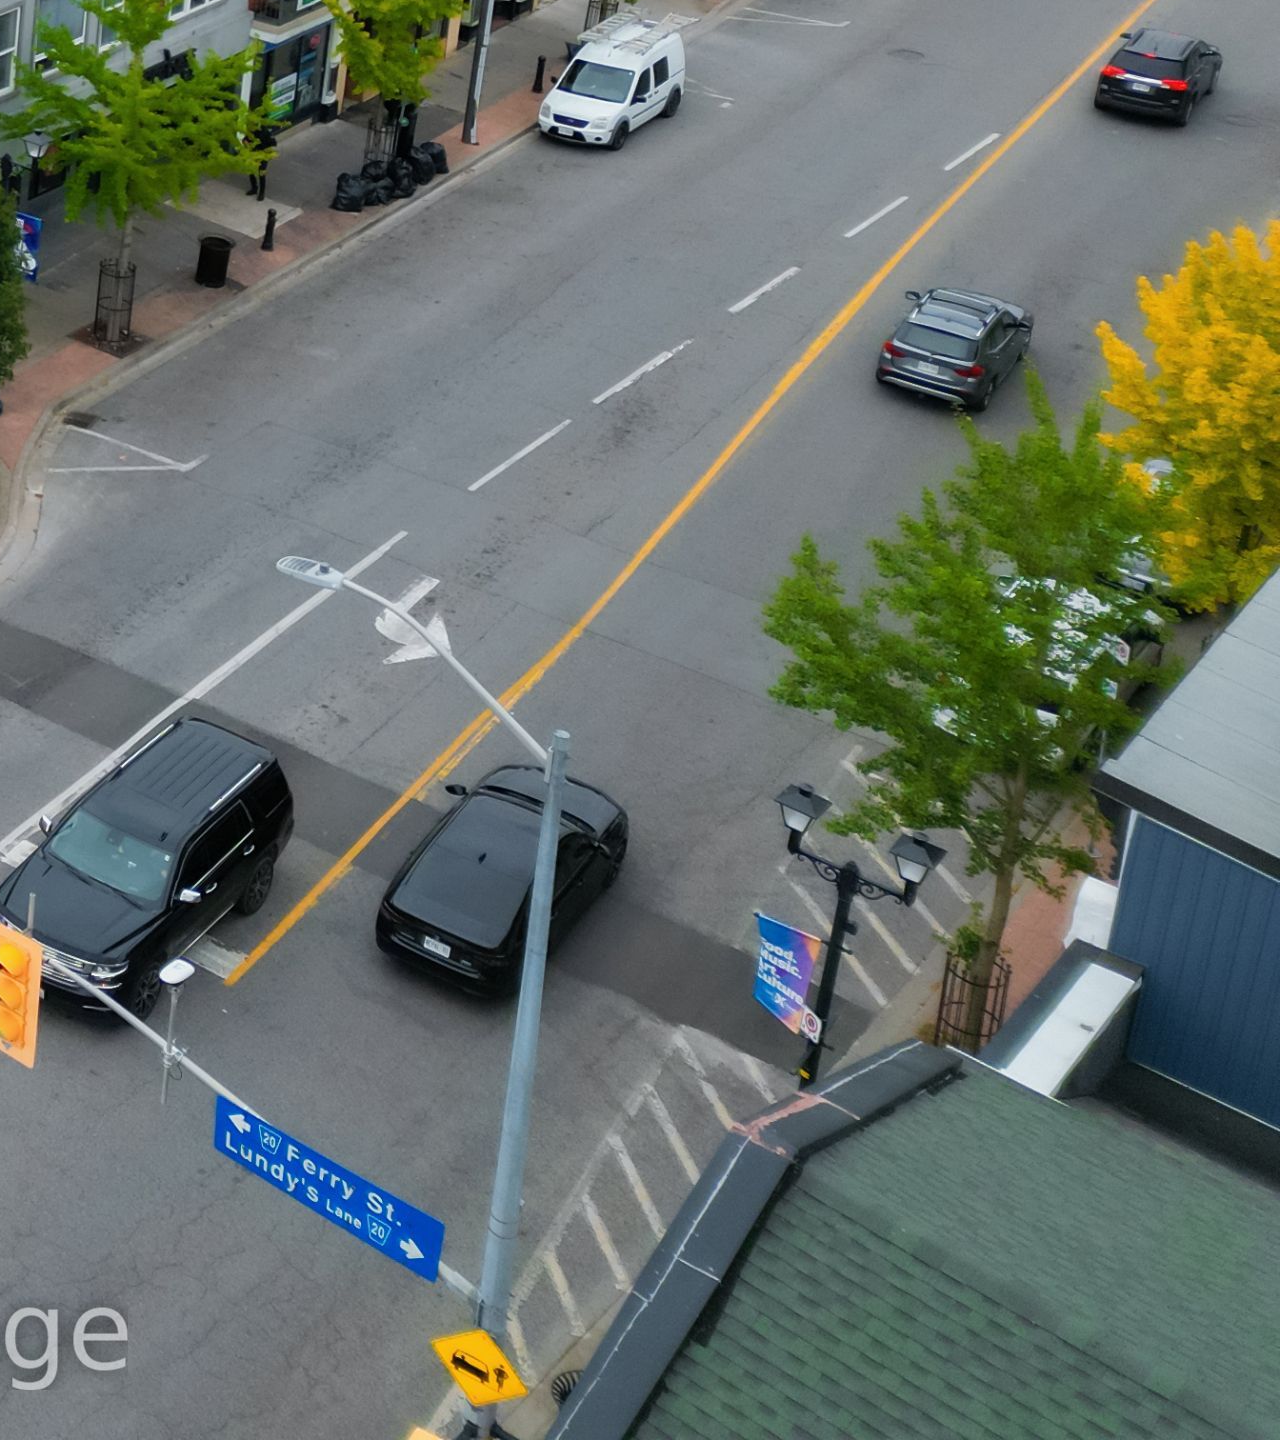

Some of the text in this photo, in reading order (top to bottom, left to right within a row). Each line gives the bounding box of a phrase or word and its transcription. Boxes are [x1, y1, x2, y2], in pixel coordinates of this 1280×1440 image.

[225, 1130, 385, 1240] Lundy's Lane 20
[262, 1132, 402, 1228] 20 Ferry St.
